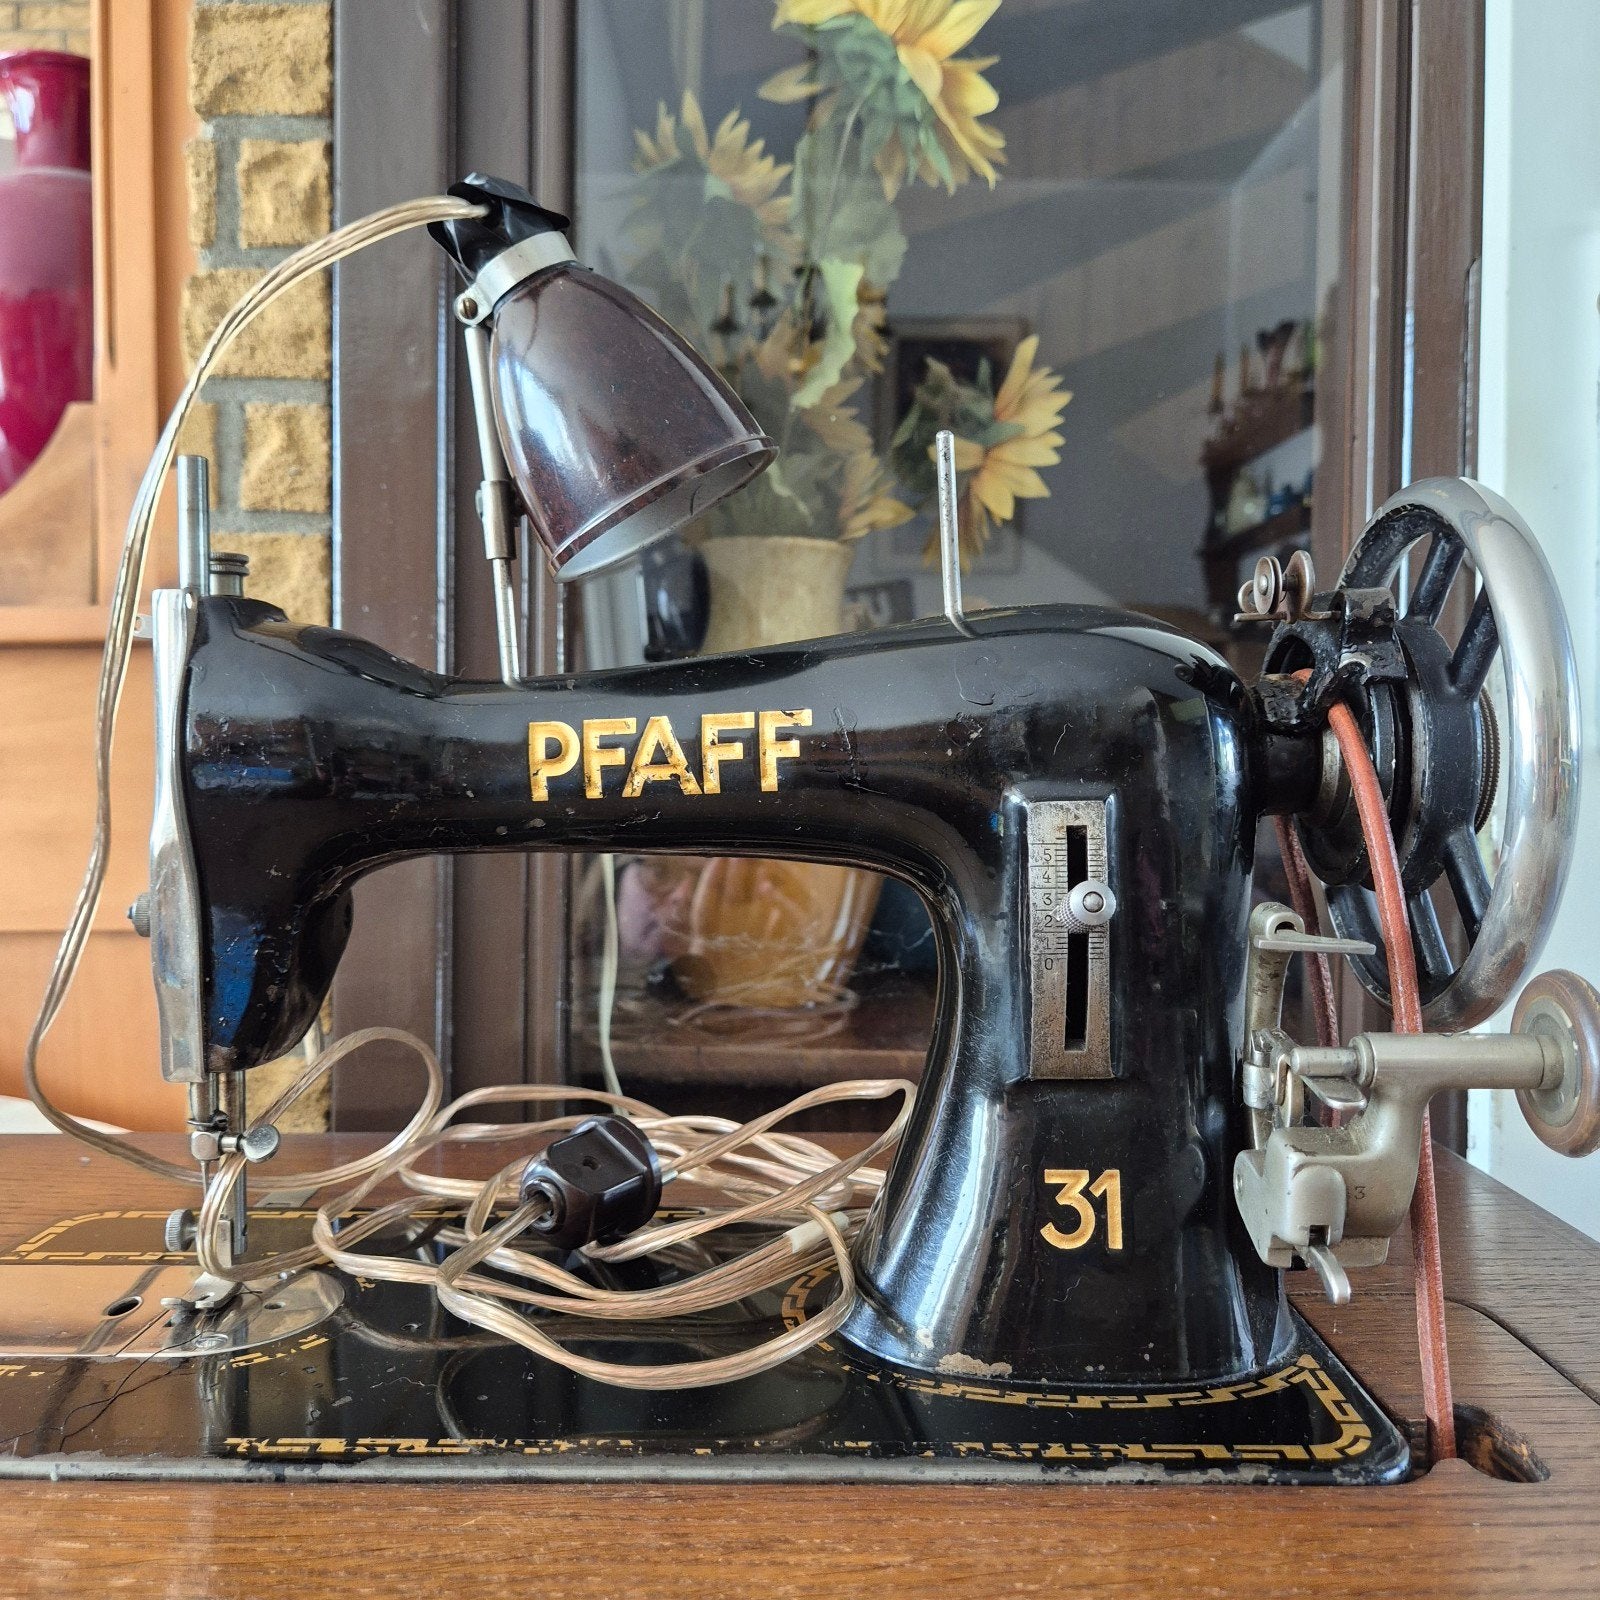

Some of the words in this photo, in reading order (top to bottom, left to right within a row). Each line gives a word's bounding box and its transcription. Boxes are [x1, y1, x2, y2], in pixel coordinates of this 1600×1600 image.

[528, 709, 812, 802] PFAFF
[1043, 848, 1052, 862] 5
[1042, 871, 1052, 884] 4
[1043, 892, 1053, 906] 3
[1044, 914, 1053, 928] 2
[1354, 1185, 1366, 1200] 3
[1040, 1169, 1123, 1250] 31
